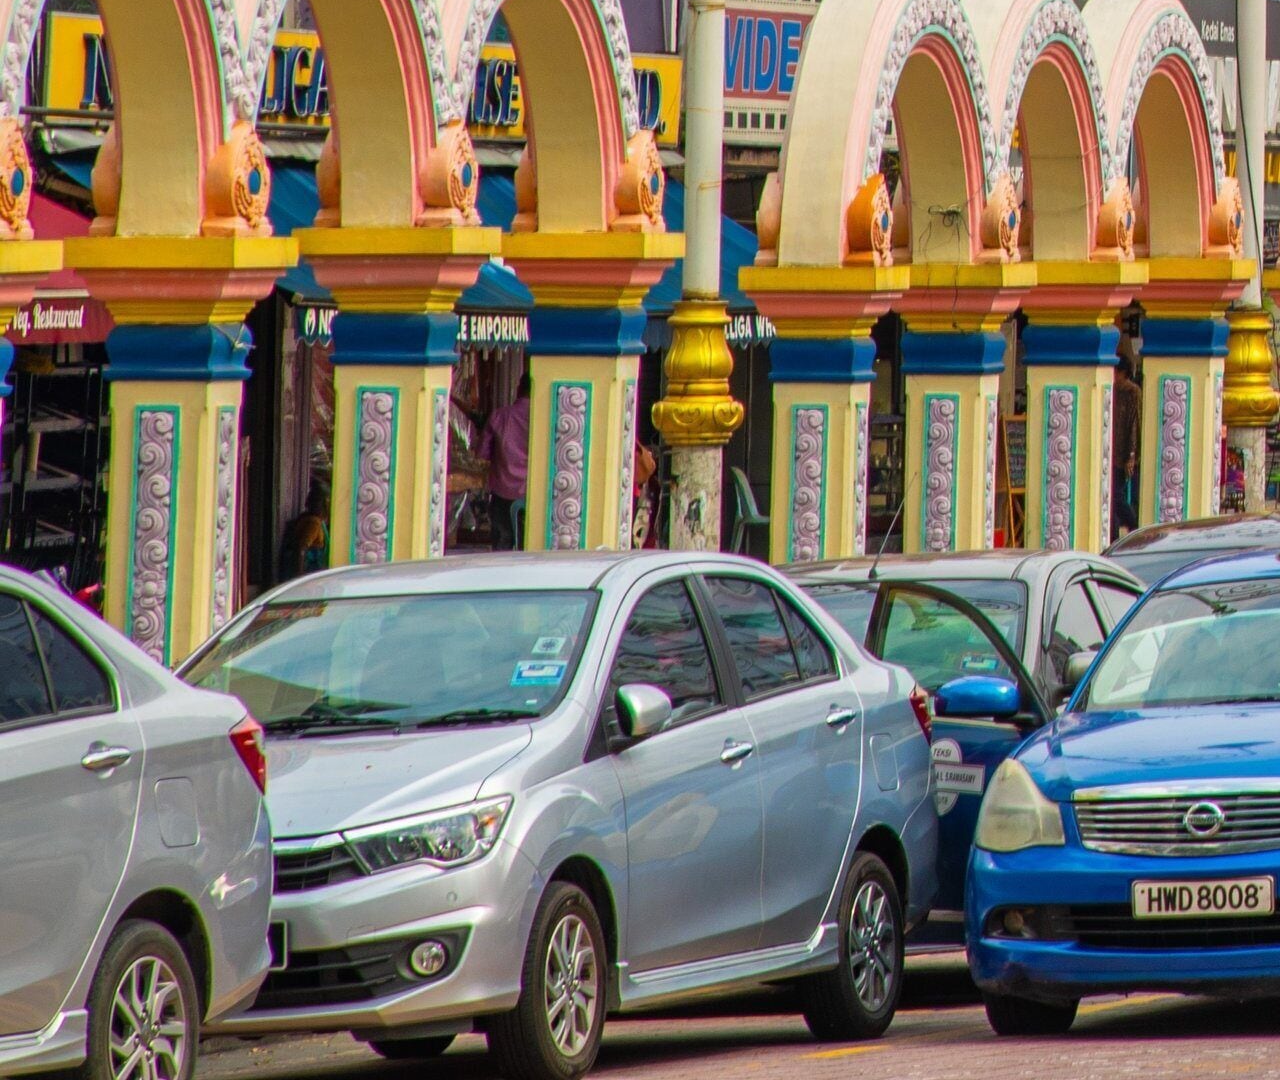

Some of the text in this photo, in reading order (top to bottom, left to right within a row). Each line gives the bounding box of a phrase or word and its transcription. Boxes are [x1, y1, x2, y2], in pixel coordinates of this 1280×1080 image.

[1201, 20, 1235, 43] Kedai Emas
[724, 15, 802, 93] VIDE
[470, 316, 529, 341] EMPORIUM
[933, 748, 952, 758] TEKSI
[1147, 883, 1260, 913] HWD 8008
